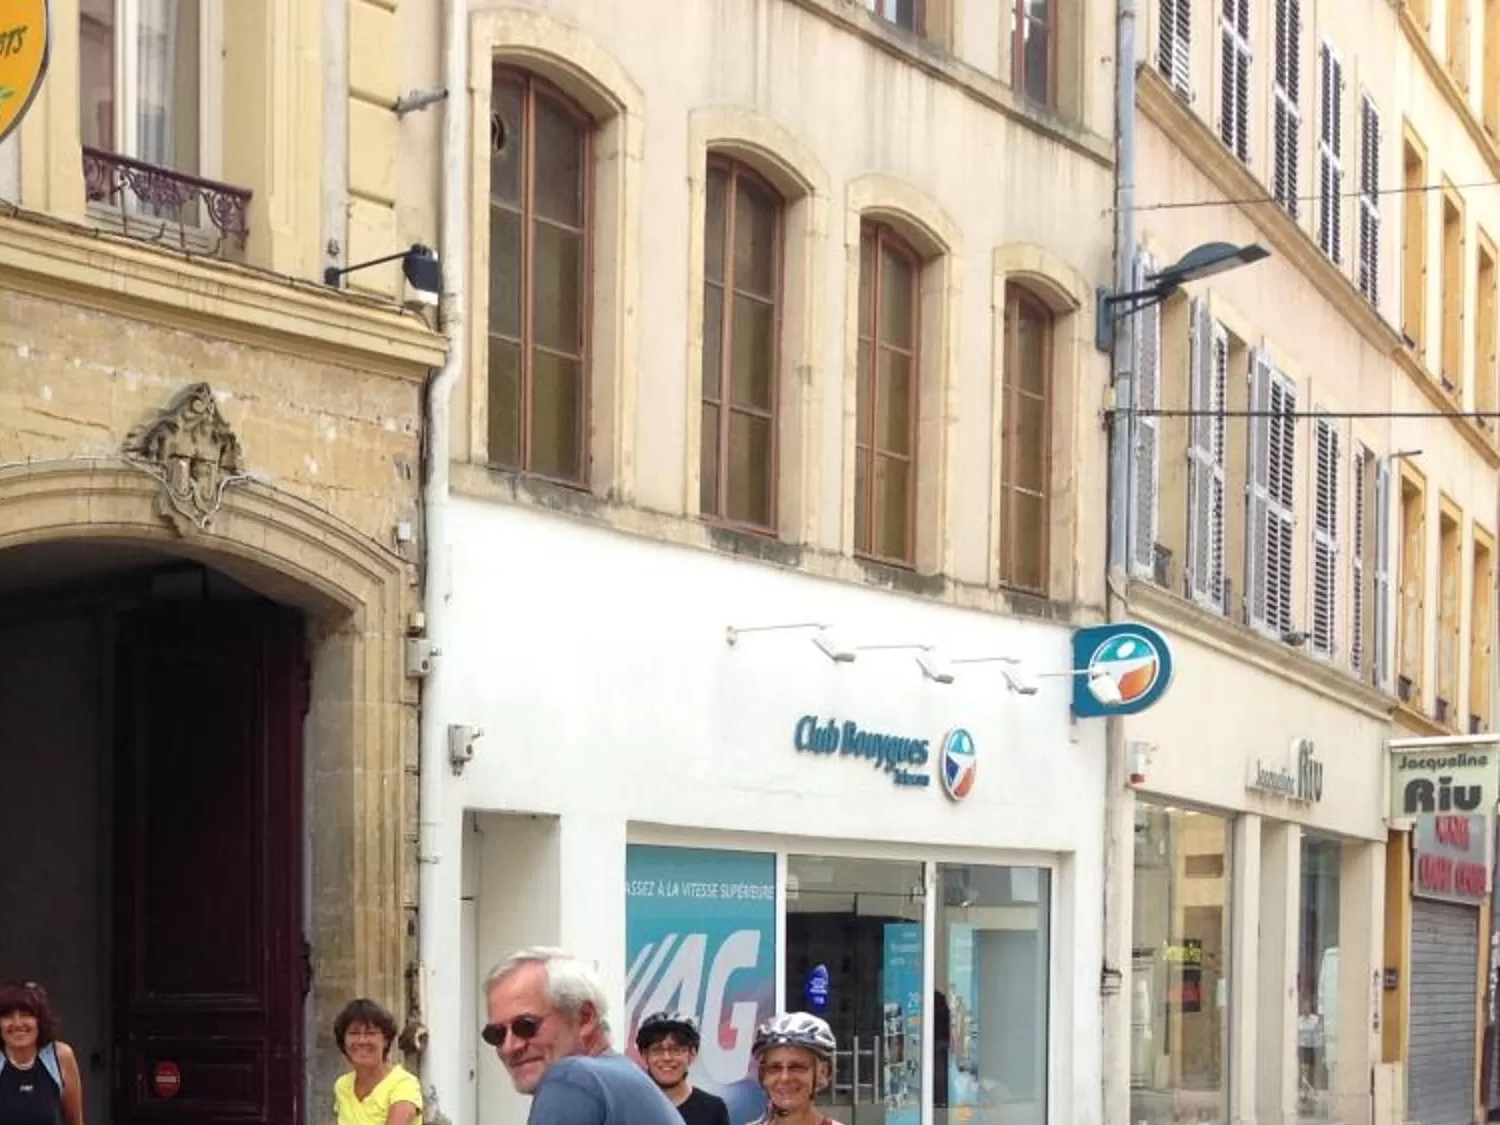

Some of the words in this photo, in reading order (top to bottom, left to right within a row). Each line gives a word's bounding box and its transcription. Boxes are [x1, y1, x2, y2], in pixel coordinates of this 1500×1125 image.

[794, 714, 841, 755] Club
[839, 719, 929, 773] Bouygues
[1398, 752, 1488, 772] Jacqueline
[1403, 776, 1483, 814] Riu
[666, 879, 680, 897] LA
